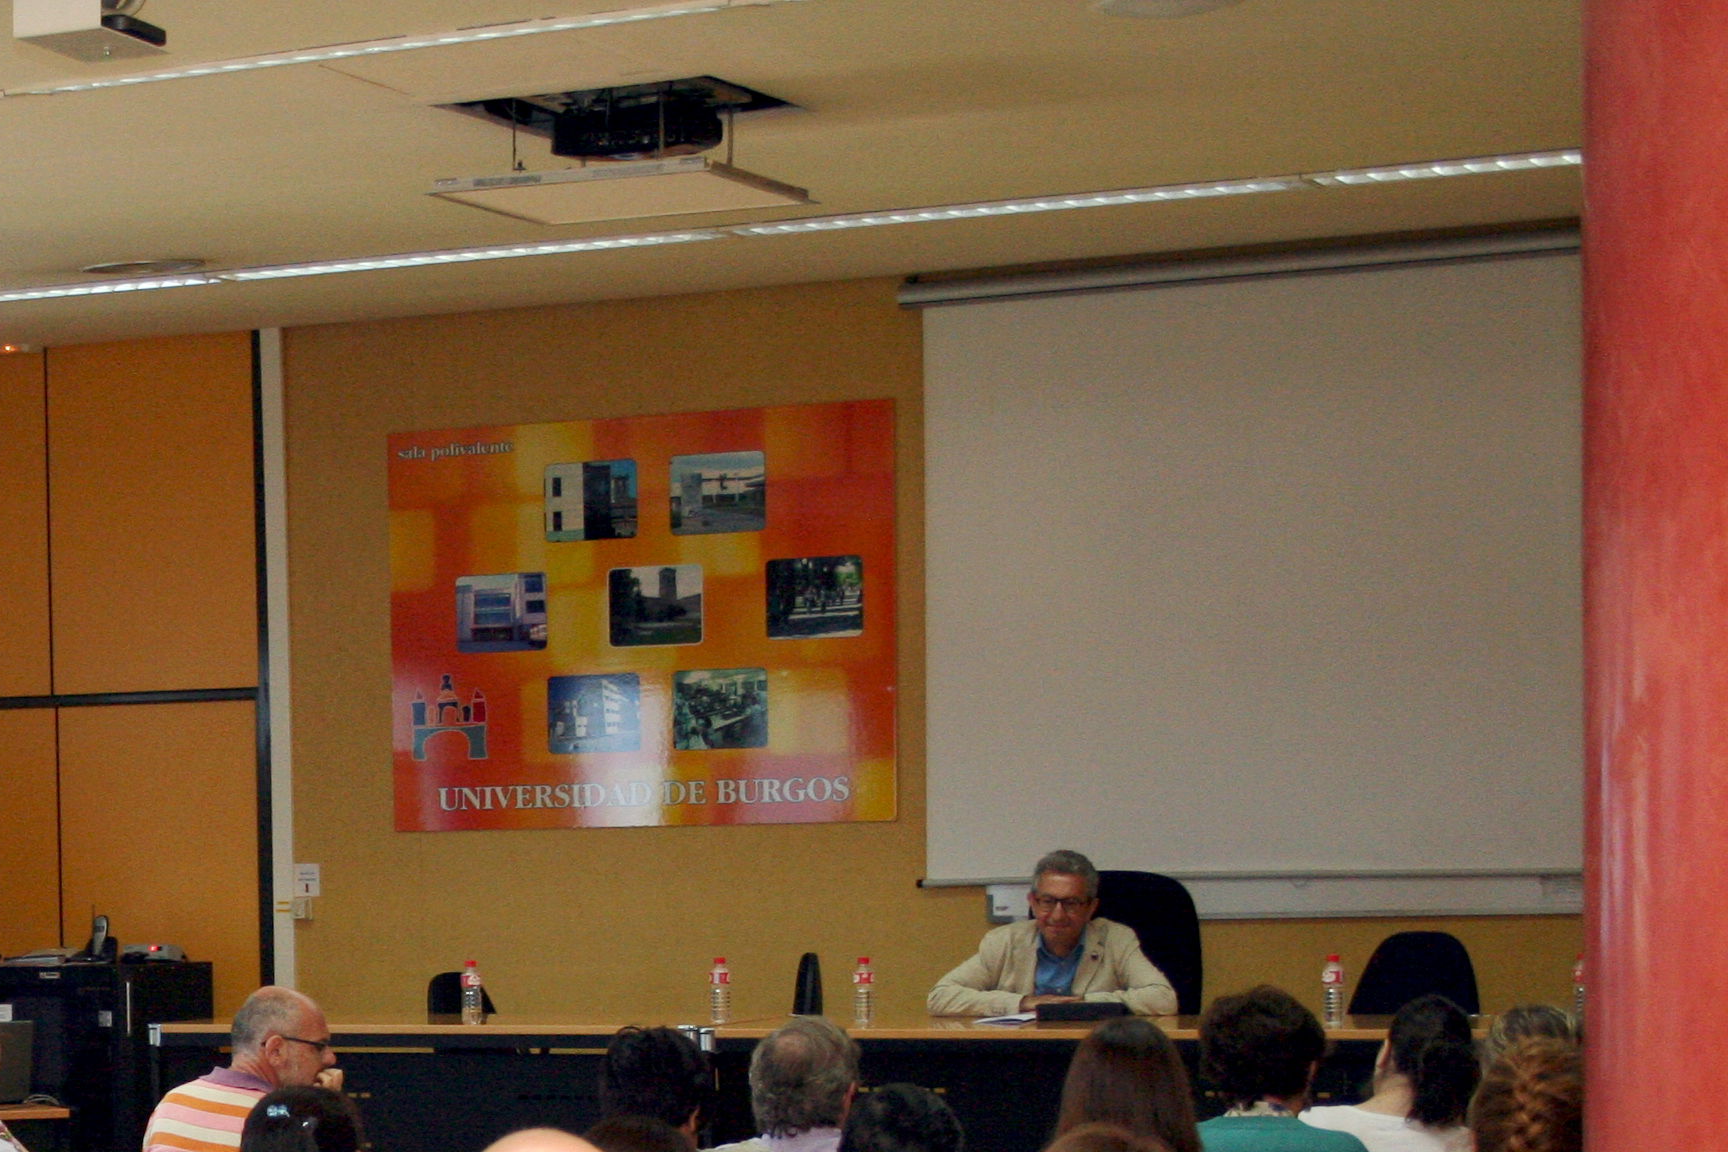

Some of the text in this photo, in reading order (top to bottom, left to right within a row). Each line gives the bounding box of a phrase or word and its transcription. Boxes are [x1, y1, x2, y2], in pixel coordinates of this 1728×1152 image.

[398, 442, 513, 461] sala polivalente
[437, 776, 850, 811] UNIVERSIDAD DE BURGOS
